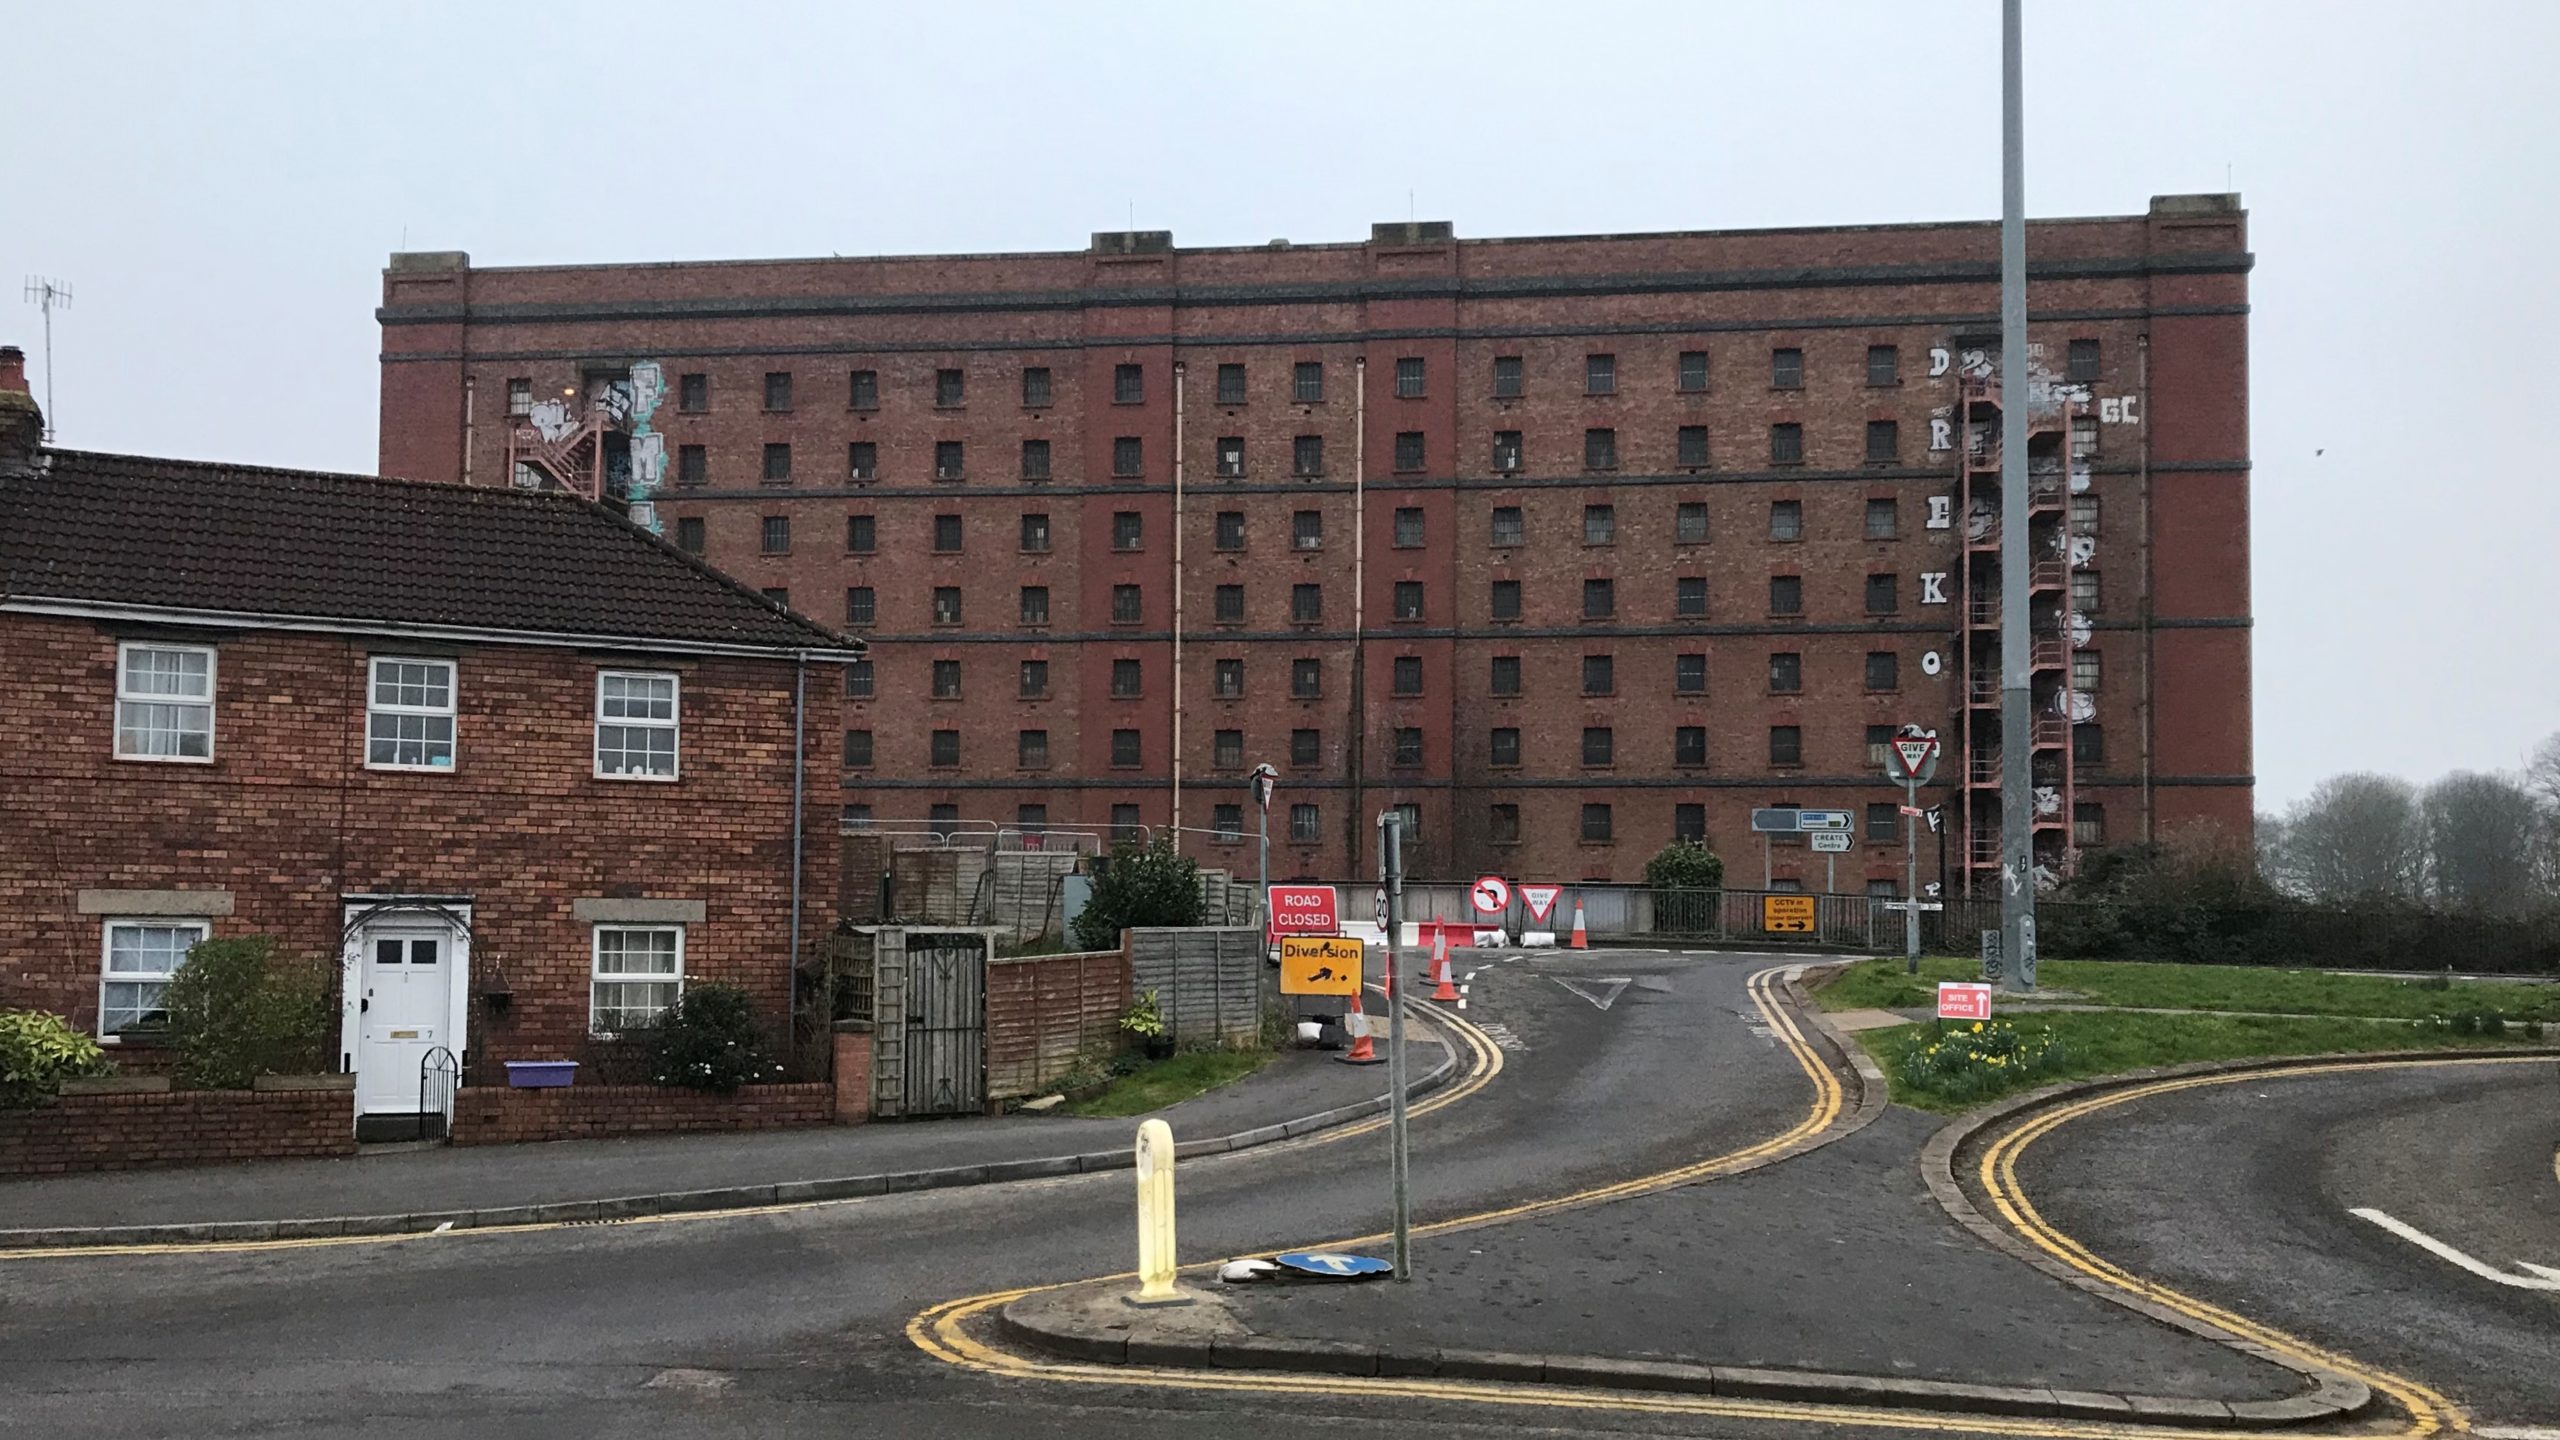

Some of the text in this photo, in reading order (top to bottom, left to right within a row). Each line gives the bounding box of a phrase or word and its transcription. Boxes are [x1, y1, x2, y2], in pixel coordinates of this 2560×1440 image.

[1900, 743, 1926, 752] GIVE
[1284, 894, 1322, 907] ROAD
[1774, 898, 1795, 906] CCTV
[1376, 898, 1388, 919] 20
[1278, 913, 1331, 926] CLOSED
[1285, 943, 1359, 959] Diversion
[1947, 993, 1969, 1002] SITE
[1941, 1003, 1975, 1013] OFFICE
